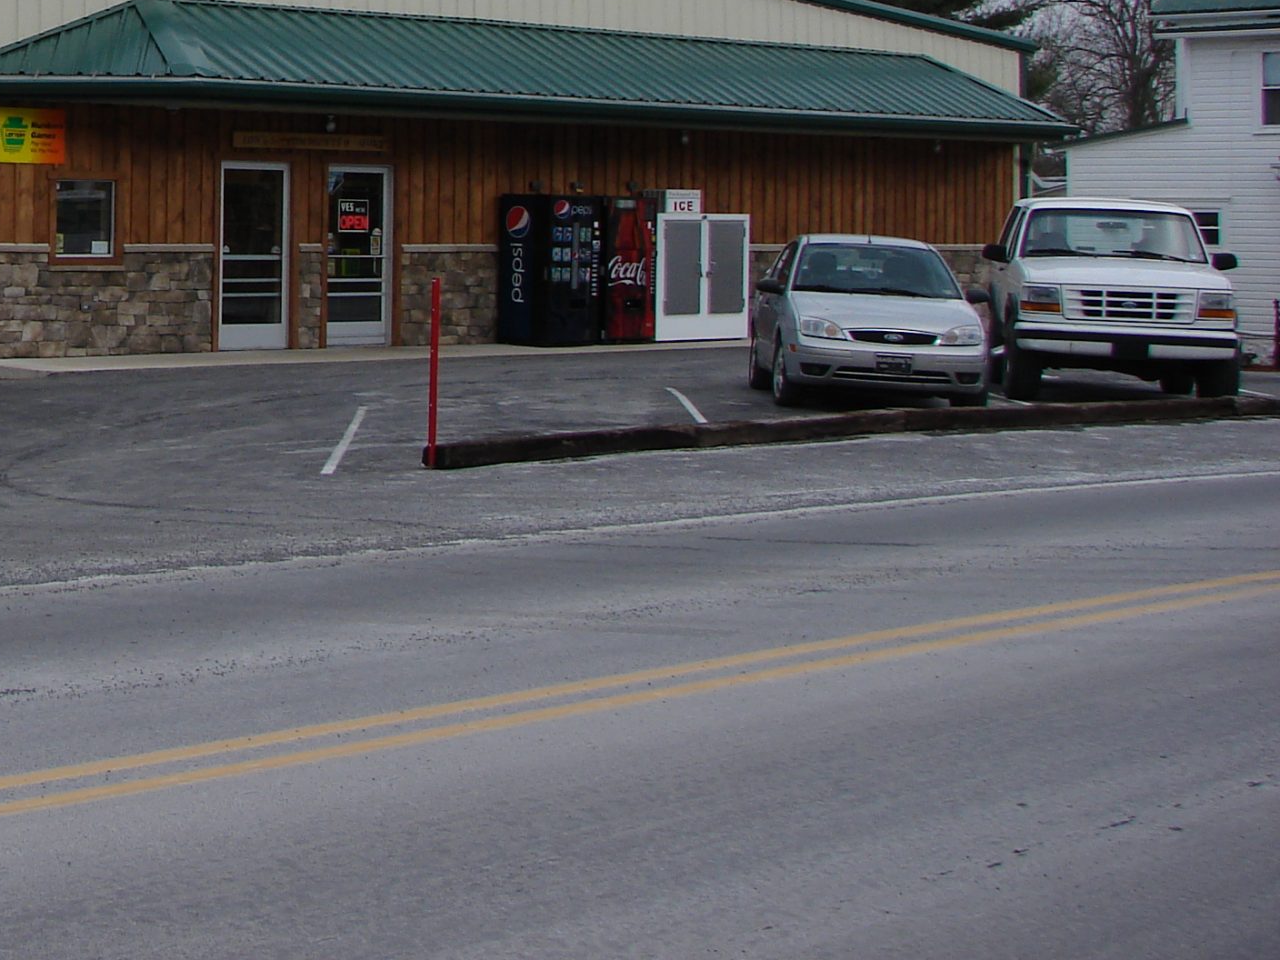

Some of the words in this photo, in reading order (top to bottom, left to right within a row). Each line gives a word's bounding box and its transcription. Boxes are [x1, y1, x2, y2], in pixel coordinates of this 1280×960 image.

[673, 201, 693, 212] ICE
[340, 215, 368, 229] OPEN
[510, 243, 525, 303] pepsi
